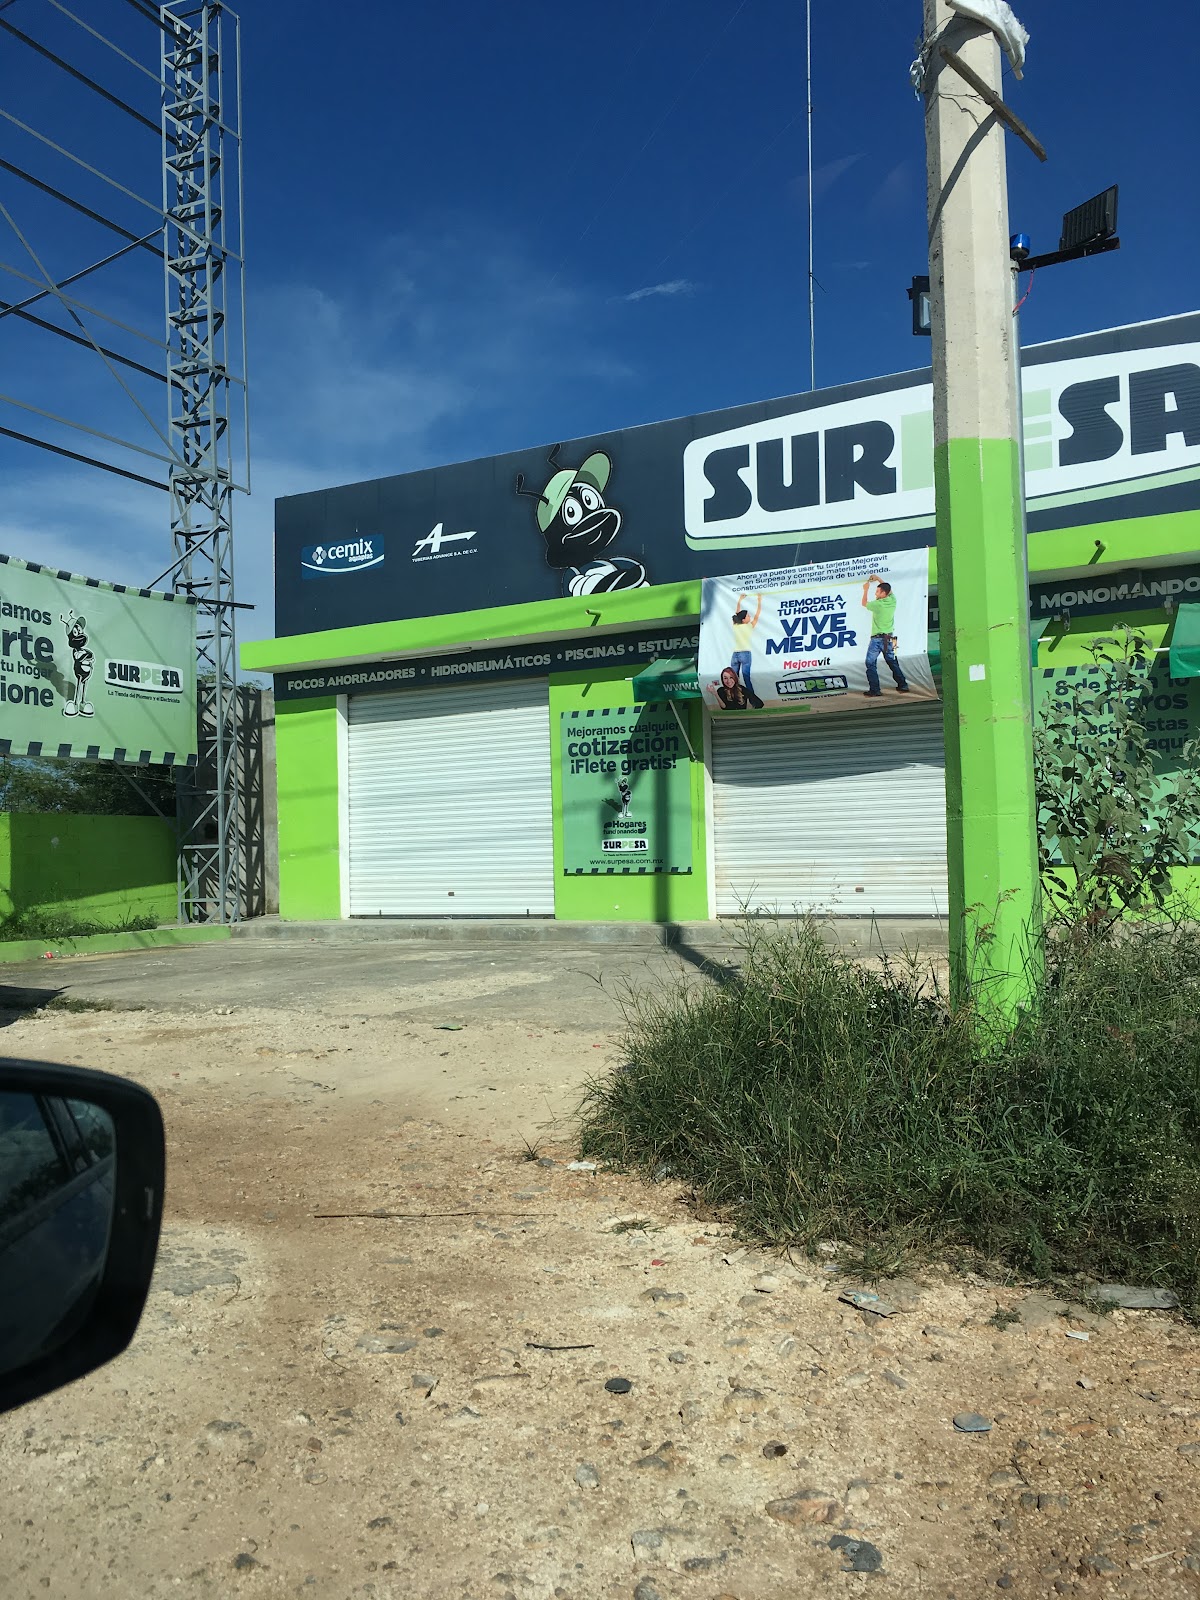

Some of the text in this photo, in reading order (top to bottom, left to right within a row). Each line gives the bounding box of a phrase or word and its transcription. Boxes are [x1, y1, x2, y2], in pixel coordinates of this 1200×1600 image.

[328, 538, 373, 559] cemix
[736, 572, 758, 581] Ahora
[769, 568, 797, 579] puedes
[797, 565, 815, 573] usar
[826, 561, 850, 570] tarjeta
[852, 555, 888, 566] Mejoravit
[755, 575, 786, 585] Surpesa
[793, 570, 825, 580] comprar
[826, 564, 867, 575] materiales
[780, 579, 797, 588] para
[807, 573, 834, 583] mejora
[857, 566, 891, 577] vivienda.
[0, 595, 52, 626] amos
[777, 601, 847, 617] TU HOGAR Y
[780, 594, 844, 609] REMODELA
[780, 612, 847, 637] VIVE
[2, 627, 54, 663] rte
[765, 630, 858, 655] MEJOR
[0, 659, 55, 680] tu hogar
[287, 635, 700, 691] FOCOS AHORRADORES HIDRONEUMÁTICOS PISCINAS ESTUFAS
[783, 656, 831, 671] Mejoravit
[107, 662, 181, 689] SURPESA
[778, 676, 846, 694] SURPESA
[0, 675, 54, 707] ione
[1055, 680, 1069, 696] 8
[1075, 677, 1101, 693] de
[567, 721, 680, 739] Mejoramos cualquier
[570, 753, 677, 776] ¡Flete gratis!
[613, 821, 647, 829] Hogares
[603, 840, 647, 849] SURPESA
[589, 858, 665, 866] www.surpesa.com.mx
